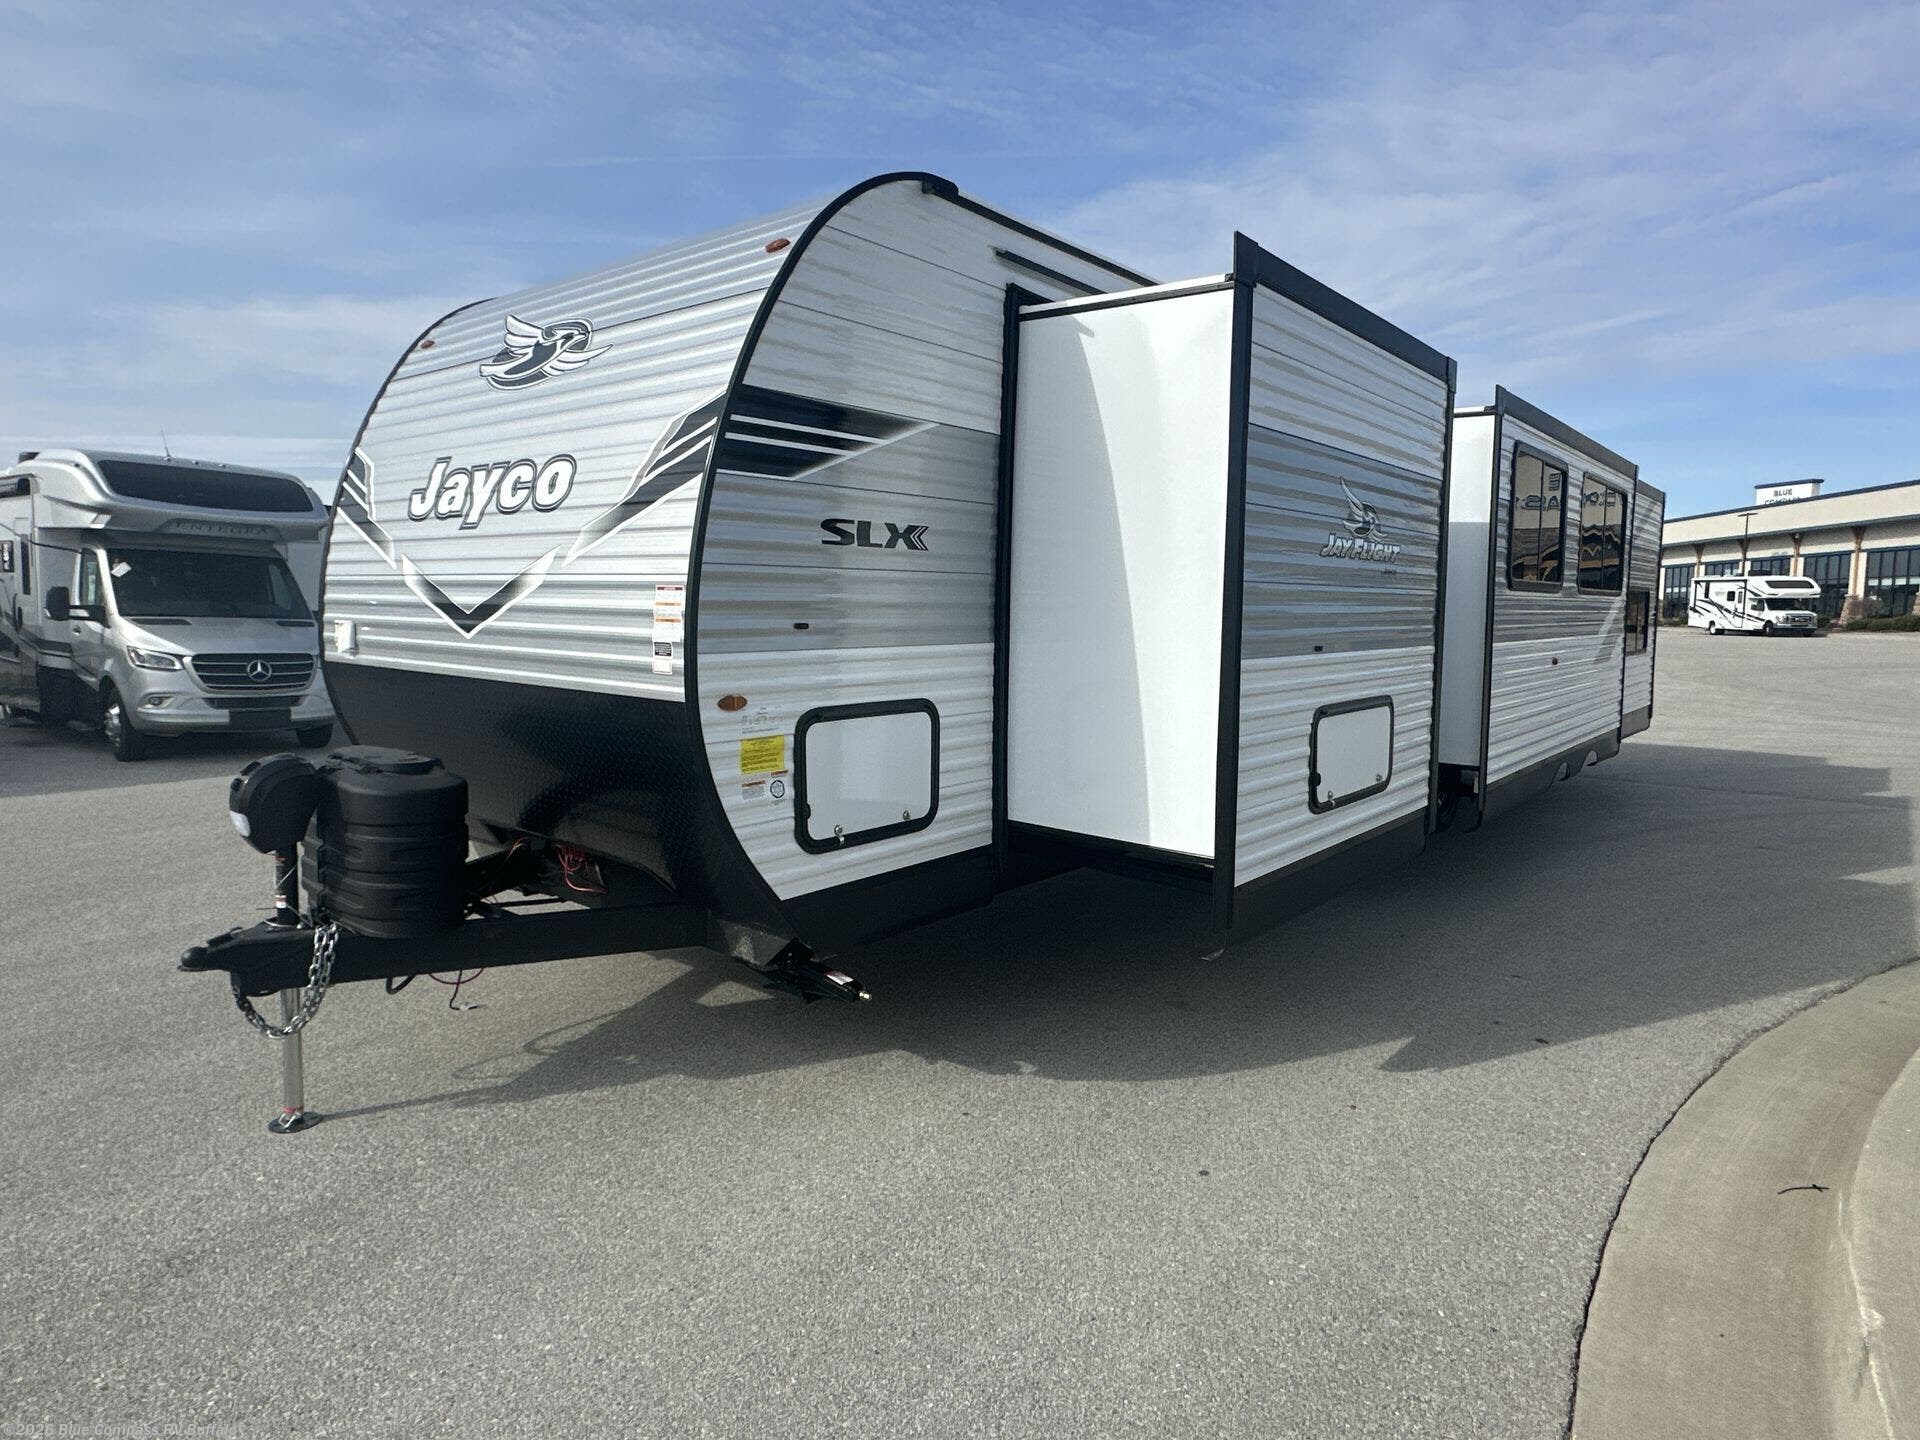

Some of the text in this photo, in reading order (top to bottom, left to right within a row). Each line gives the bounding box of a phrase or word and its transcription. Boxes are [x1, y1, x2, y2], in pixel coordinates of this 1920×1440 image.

[408, 454, 577, 530] Jayco
[1773, 489, 1792, 497] BLUE
[820, 518, 929, 551] SLX
[1319, 532, 1400, 562] JAY FLIGHT
